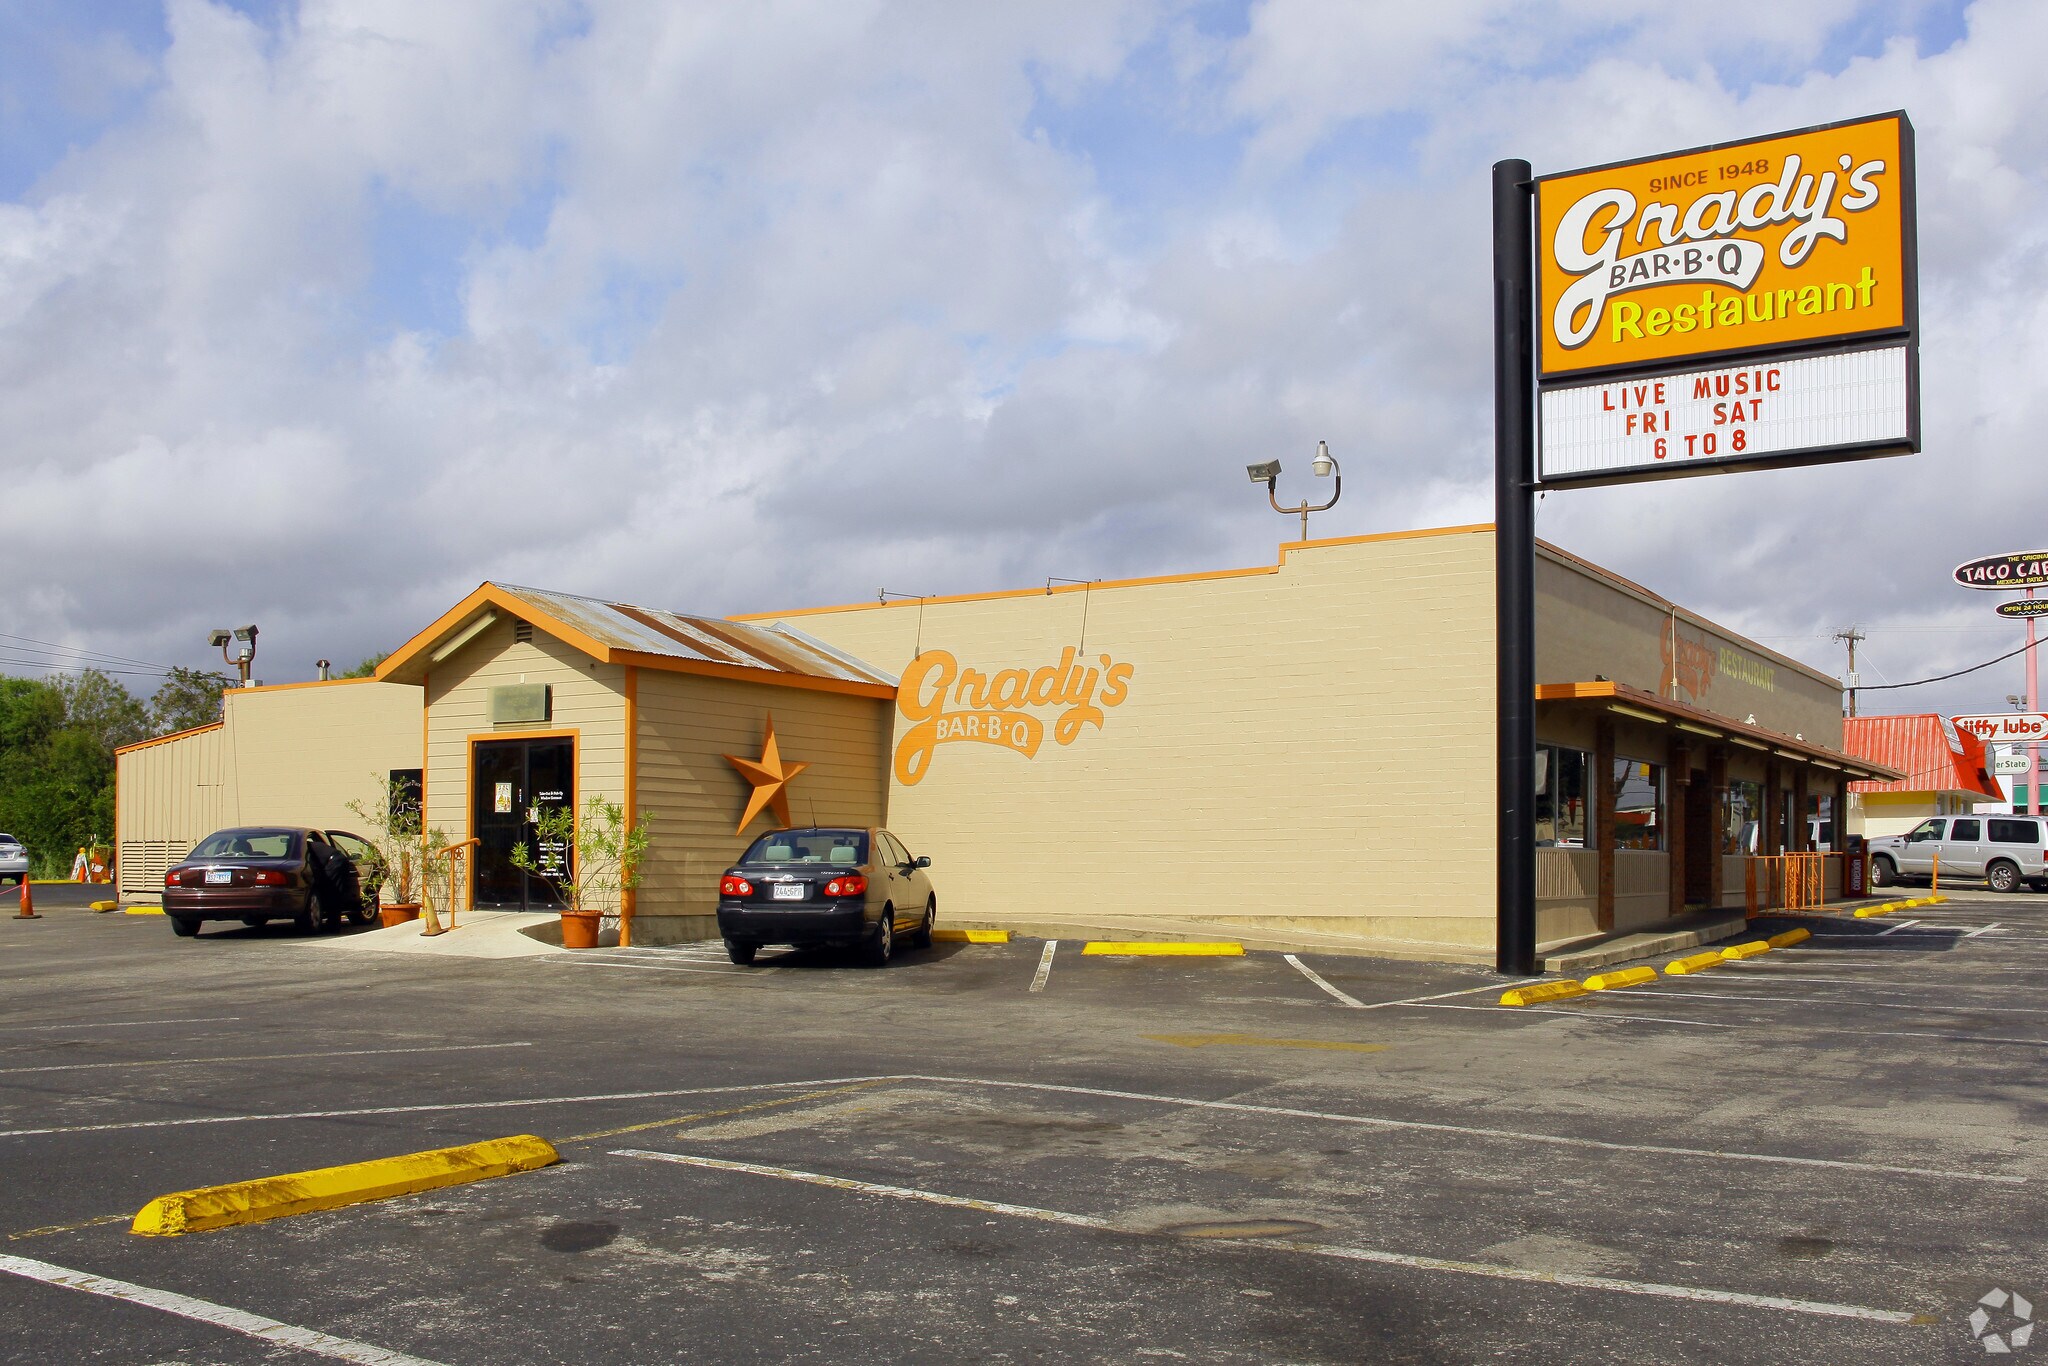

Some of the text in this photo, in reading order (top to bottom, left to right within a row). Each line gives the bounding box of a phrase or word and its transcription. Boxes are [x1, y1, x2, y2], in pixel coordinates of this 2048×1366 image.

[1649, 159, 1769, 193] SINCE 1948
[1553, 154, 1885, 349] Grady's
[1611, 266, 1878, 343] Restaurant
[1603, 369, 1781, 411] LIVE MUSIC
[1626, 399, 1763, 436] FRI SAT
[1654, 429, 1747, 459] 6 TO 8
[1962, 564, 2010, 581] TACO
[1996, 578, 2024, 586] MEXICAN
[1719, 647, 1775, 693] RESTAURANT
[894, 645, 1135, 786] Grady's
[2003, 718, 2042, 734] lube
[2005, 760, 2026, 768] State
